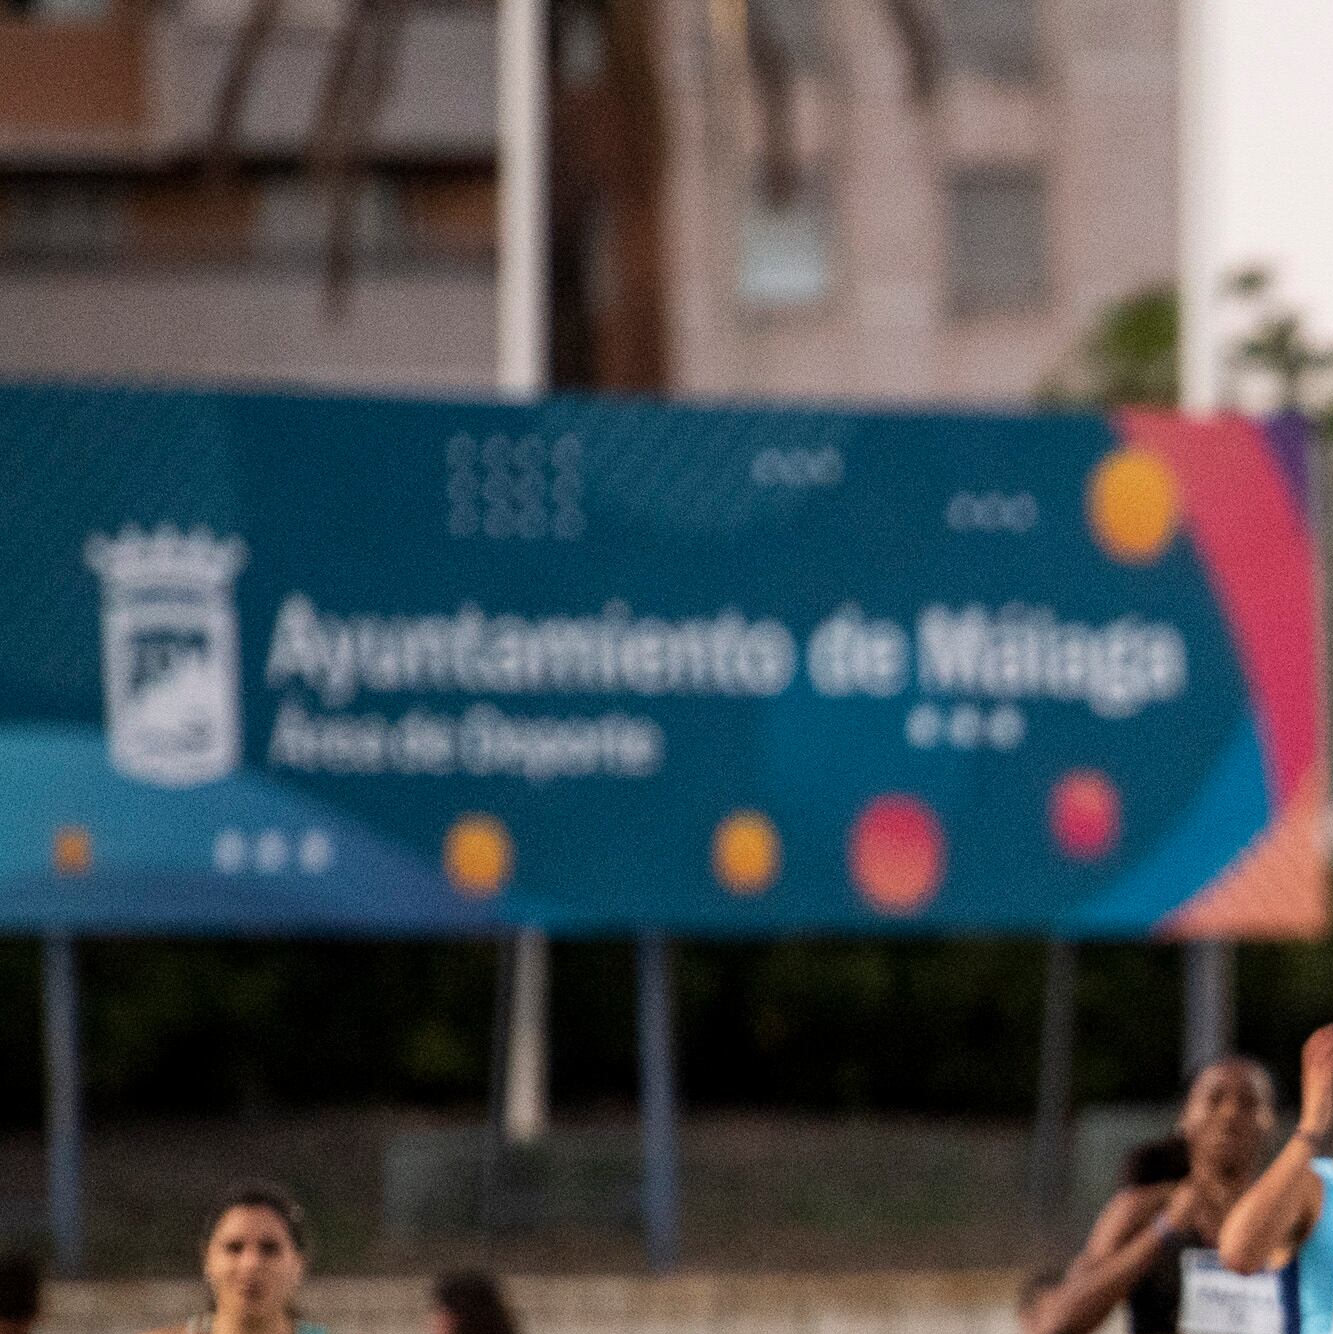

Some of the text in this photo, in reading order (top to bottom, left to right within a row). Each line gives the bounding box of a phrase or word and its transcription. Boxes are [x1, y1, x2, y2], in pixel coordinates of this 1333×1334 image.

[268, 593, 1187, 718] Ayuntamiento de Málaga
